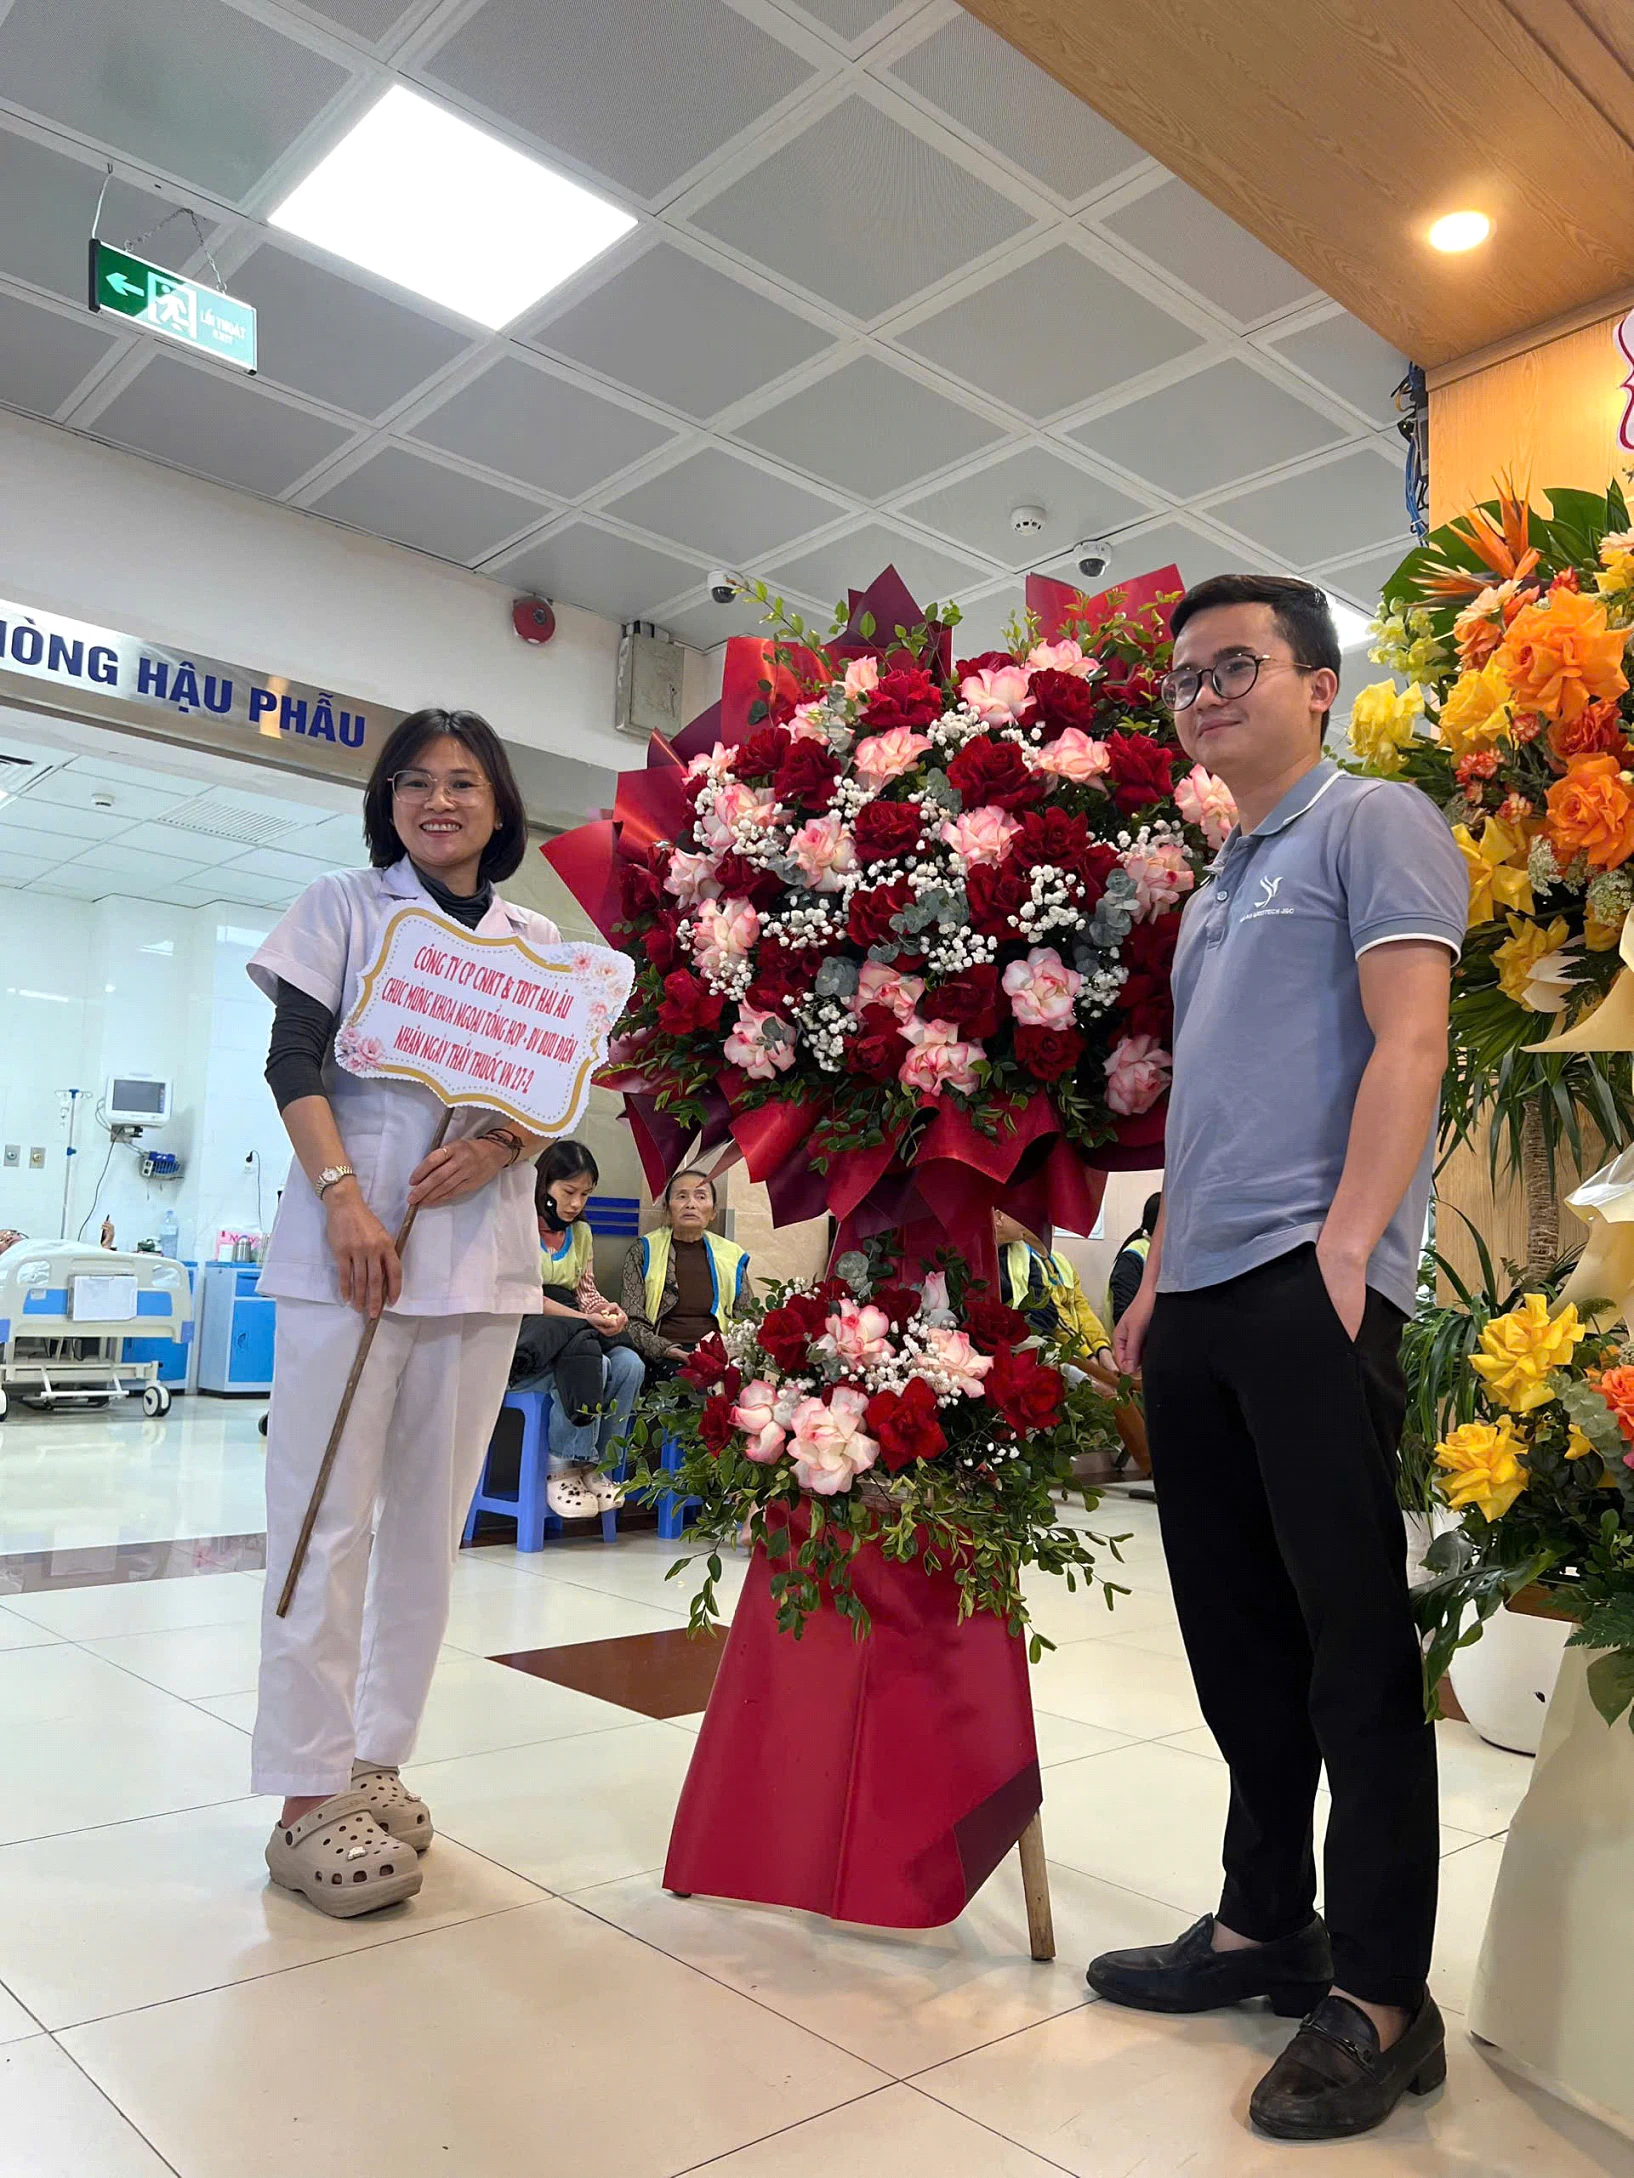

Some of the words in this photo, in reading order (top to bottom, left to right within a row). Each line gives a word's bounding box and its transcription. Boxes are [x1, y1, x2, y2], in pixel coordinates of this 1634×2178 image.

[137, 657, 233, 713] HẬU
[248, 687, 366, 748] PHẪU
[381, 975, 409, 1006] CHÚC
[403, 981, 434, 1014] MỪNG
[428, 993, 458, 1024] KHOA
[453, 1001, 486, 1036] NGOẠI
[480, 1004, 510, 1041] TỔNG
[504, 1019, 528, 1051] HỢP
[525, 1027, 544, 1051] BV
[536, 1031, 560, 1058] BƯU
[553, 1033, 579, 1068] ĐIỆN
[413, 943, 448, 976] CÔNG
[444, 956, 463, 982] TY
[458, 961, 476, 986] CP
[472, 967, 506, 996] CNKT
[501, 976, 514, 1000] &
[512, 980, 541, 1009] TBYT
[535, 982, 559, 1015] HẢI
[553, 989, 575, 1020] ÂU
[393, 1024, 424, 1056] NHÂN
[419, 1033, 451, 1065] NGÀY
[445, 1040, 475, 1073] THẦY
[468, 1049, 504, 1083] THUỐC
[498, 1061, 517, 1087] VN
[510, 1066, 536, 1094] 27-2
